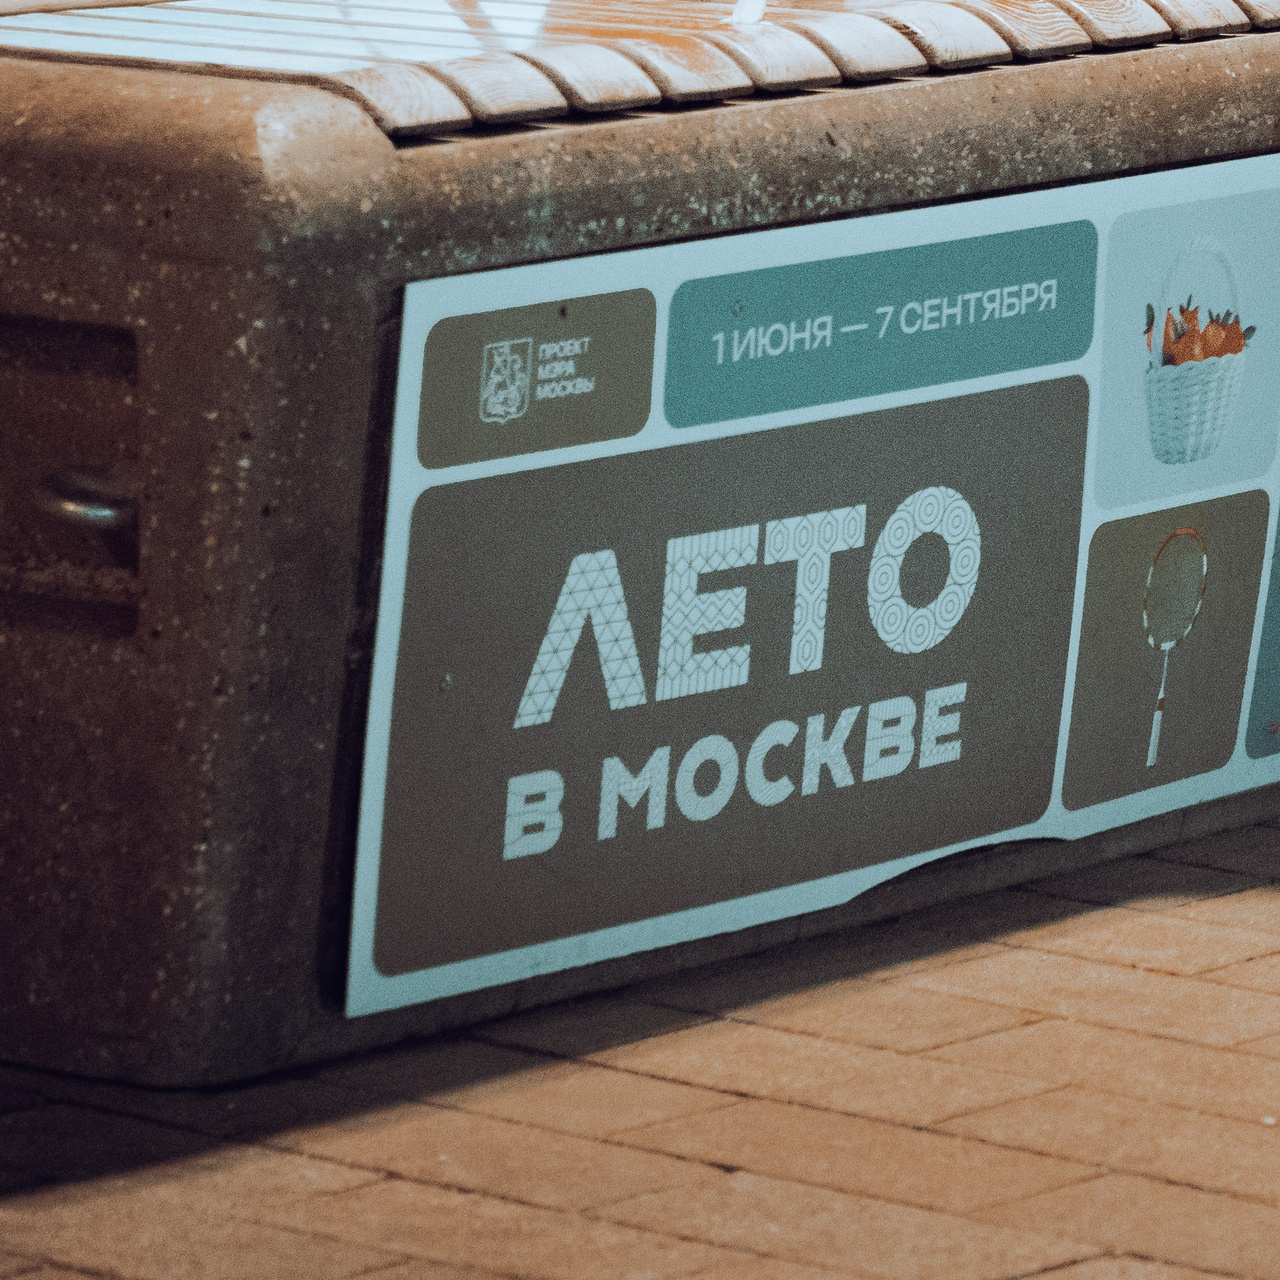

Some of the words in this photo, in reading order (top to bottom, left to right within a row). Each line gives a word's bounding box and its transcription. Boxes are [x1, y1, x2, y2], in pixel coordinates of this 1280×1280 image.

[712, 332, 726, 366] 1
[732, 315, 833, 363] ИЮНЯ
[876, 306, 895, 339] 7
[900, 279, 1059, 335] СЕНТЯБРЯ
[513, 485, 982, 729] ЛЕТО
[503, 769, 565, 861] В
[597, 682, 968, 841] МОСКВЕ
